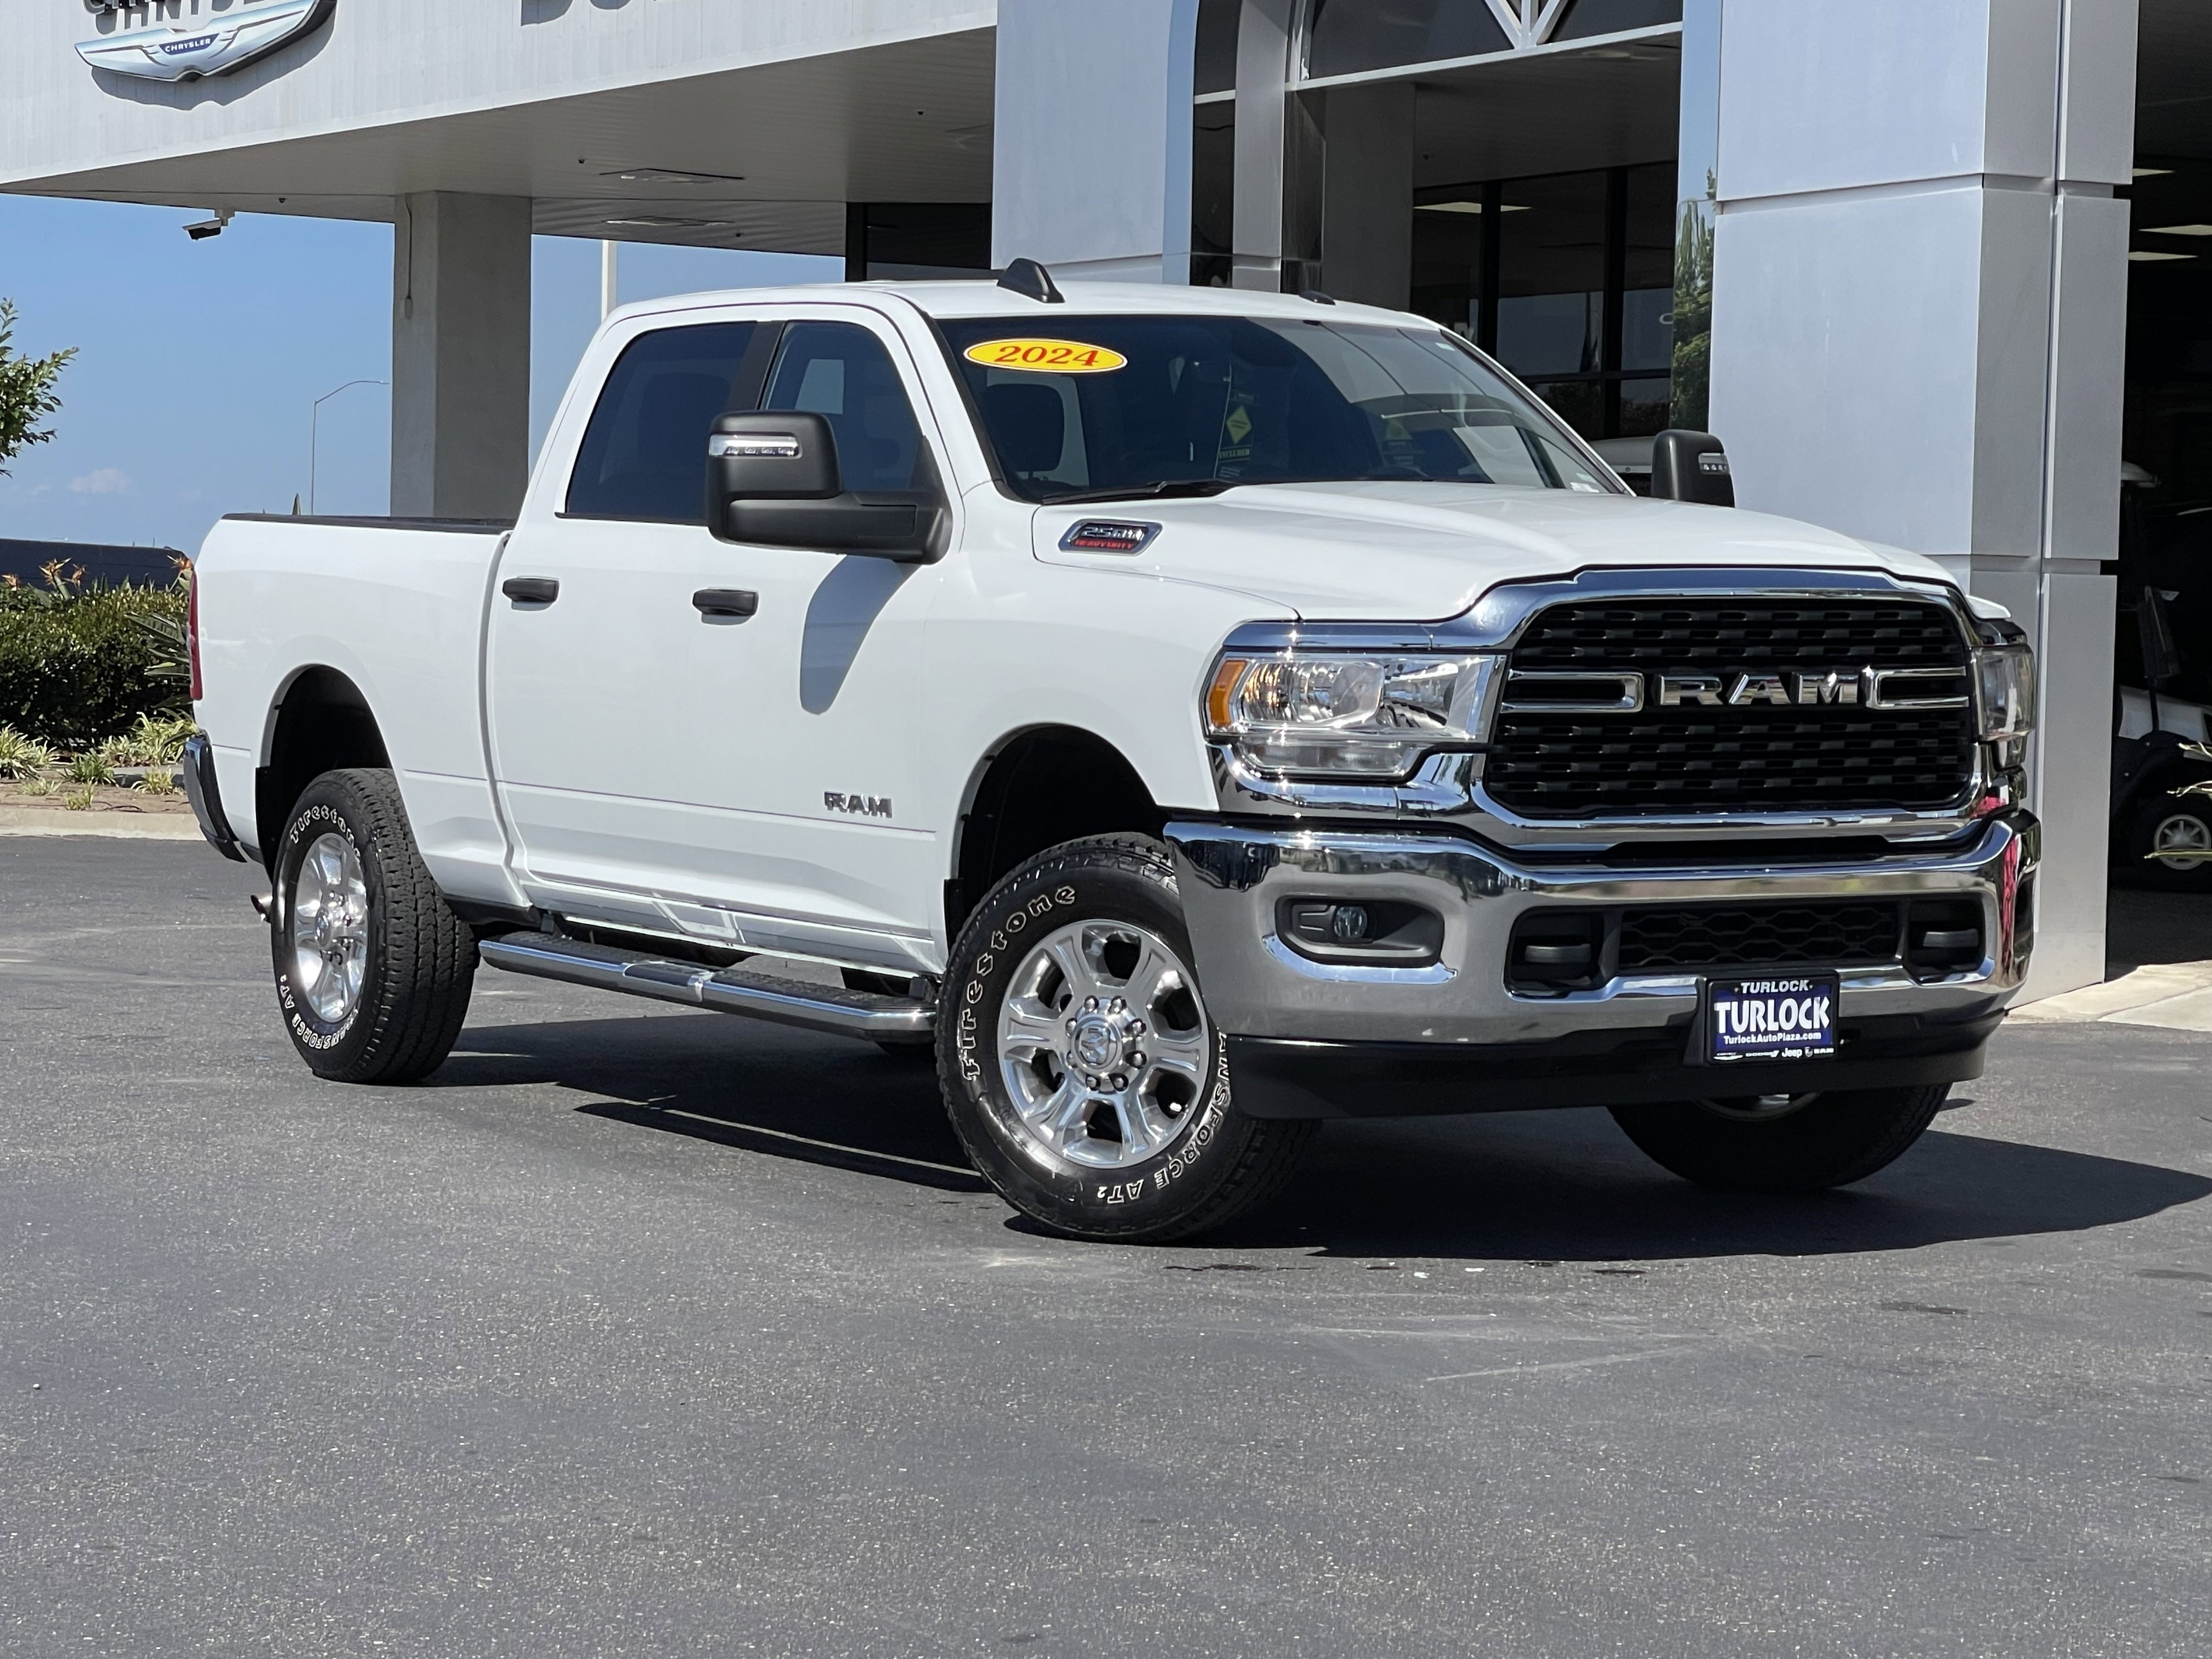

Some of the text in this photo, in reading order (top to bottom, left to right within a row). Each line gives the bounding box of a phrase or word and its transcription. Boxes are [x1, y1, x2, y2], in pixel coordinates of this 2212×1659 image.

[165, 38, 211, 53] CHRYSLER
[995, 345, 1099, 367] 2024
[1655, 670, 1861, 707] RAM
[824, 791, 892, 819] RAM
[960, 885, 1076, 1081] Firestone
[1740, 979, 1810, 994] TURLOCK
[1714, 996, 1831, 1034] TURLOCK
[1723, 1032, 1821, 1045] TurlockAutoPlaza.com
[1782, 1048, 1803, 1058] Jeep
